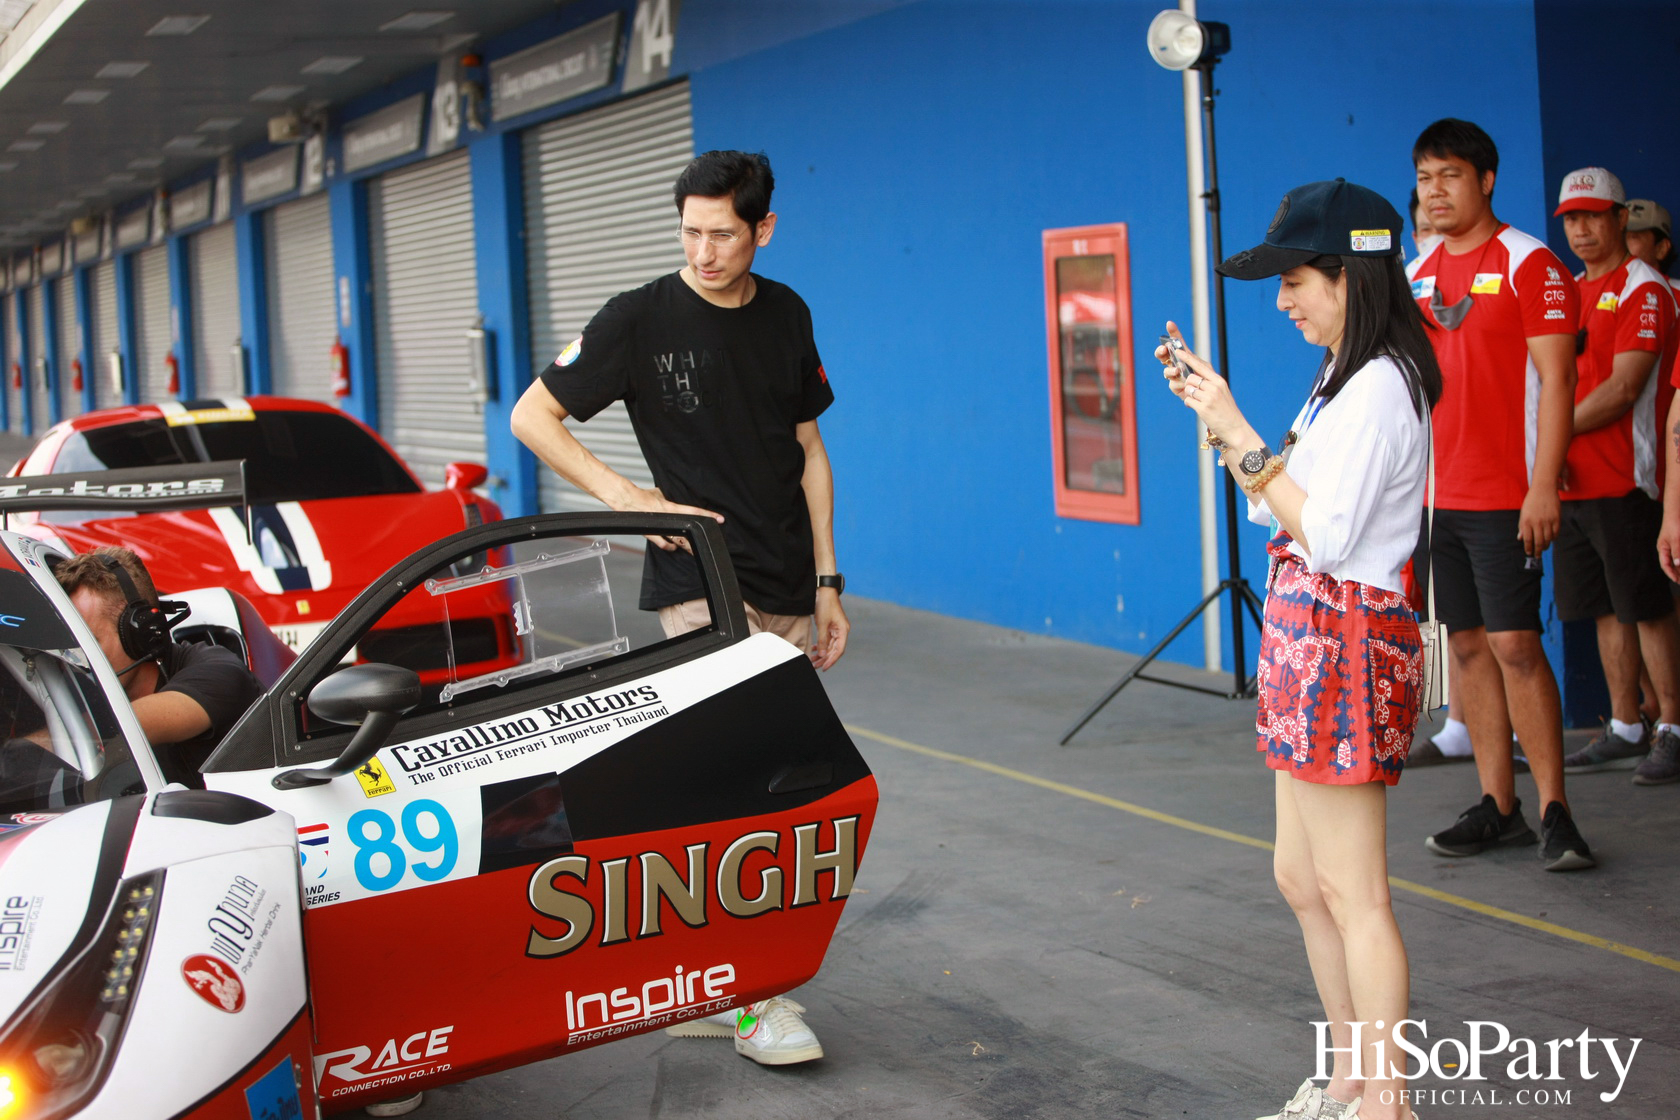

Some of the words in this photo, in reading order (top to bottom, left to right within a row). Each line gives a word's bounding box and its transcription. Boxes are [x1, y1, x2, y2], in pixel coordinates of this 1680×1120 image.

[634, 0, 673, 72] 14
[1543, 290, 1565, 301] CTG
[390, 716, 539, 772] Cavallino
[538, 685, 659, 727] Motors
[408, 772, 436, 785] The
[438, 754, 493, 777] Official
[495, 739, 547, 761] Ferrari
[549, 722, 611, 746] Importer
[613, 705, 670, 728] Thailand
[367, 785, 392, 796] Ferrari
[346, 799, 459, 892] 89
[307, 891, 341, 906] SERIES
[525, 814, 861, 960] SINGH
[260, 919, 274, 940] Herbal
[268, 902, 281, 919] Drink
[565, 963, 736, 1030] Inspire
[313, 1025, 454, 1086] RACE
[567, 1015, 672, 1046] Entertainment
[332, 1074, 406, 1097] CONNECTION
